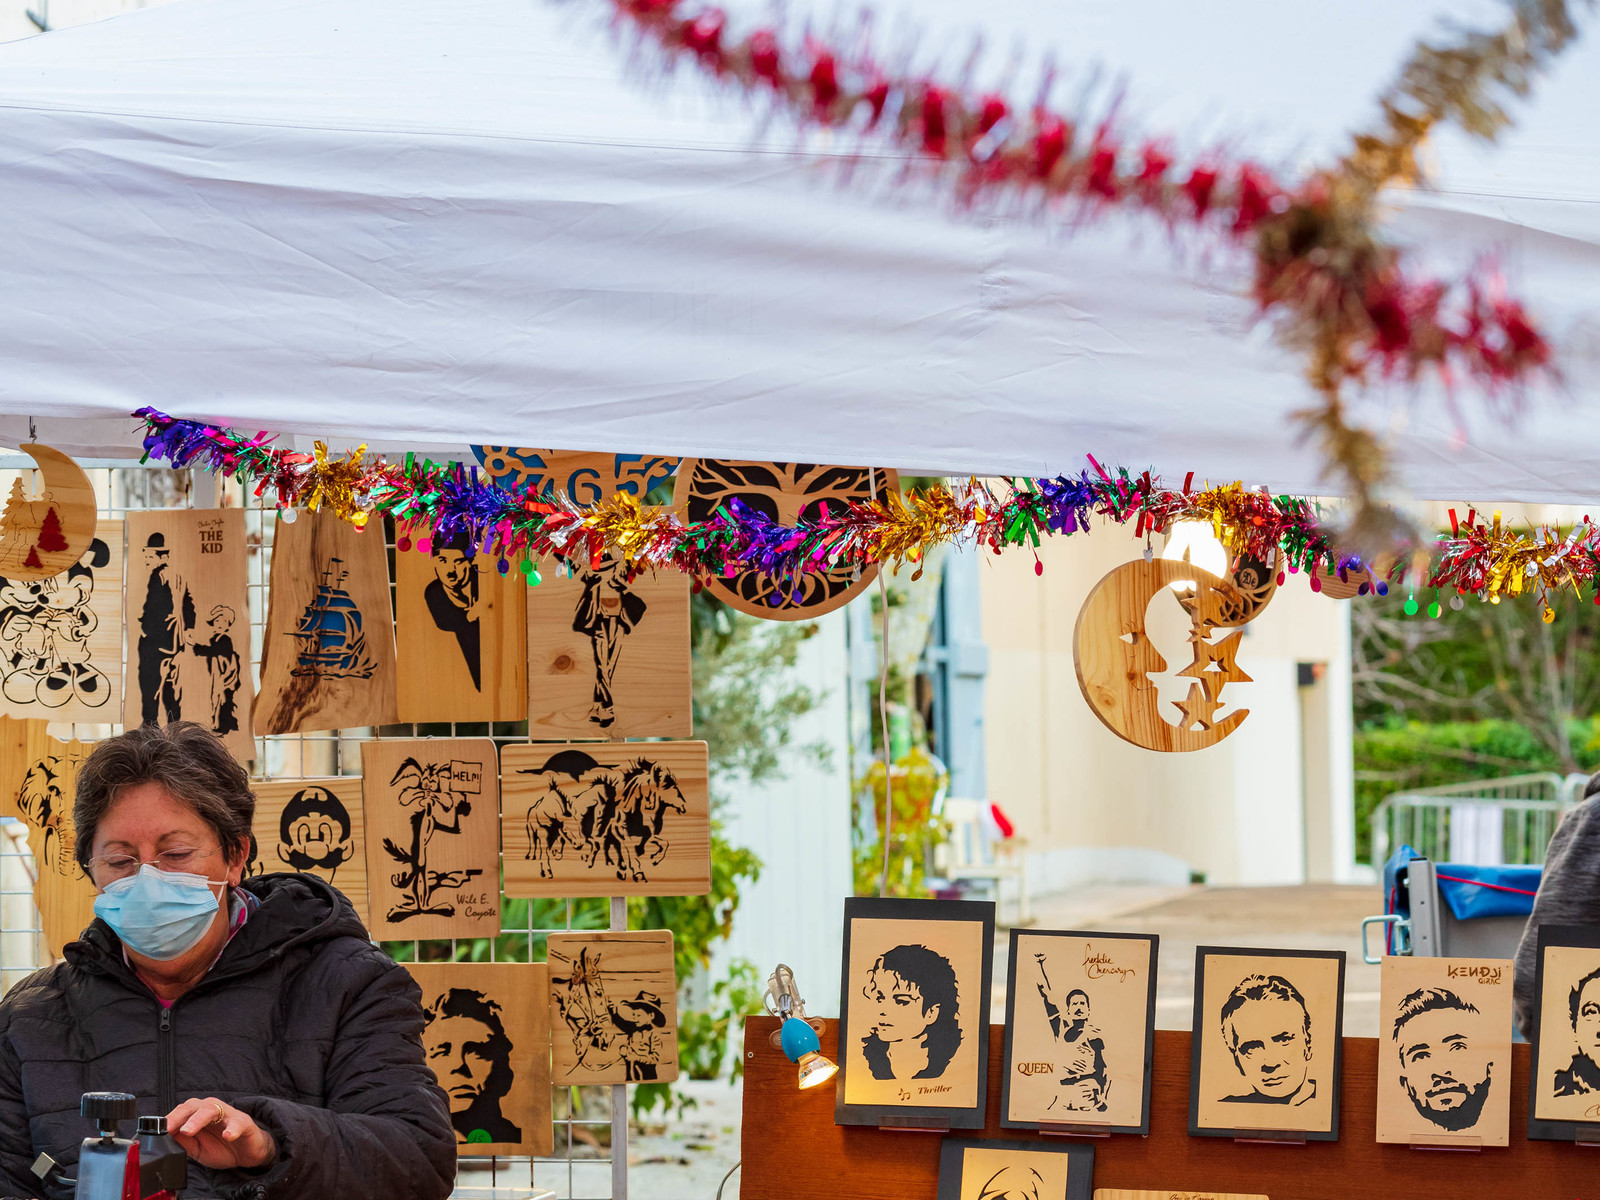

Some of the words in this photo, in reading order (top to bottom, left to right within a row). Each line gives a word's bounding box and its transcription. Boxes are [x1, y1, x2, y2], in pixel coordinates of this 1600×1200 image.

[567, 468, 602, 508] 6
[199, 530, 223, 541] THE
[201, 543, 223, 554] KID
[453, 771, 480, 784] HELP!
[456, 893, 478, 905] Wile
[464, 906, 497, 921] Coyote
[1017, 1062, 1054, 1076] QUEEN
[917, 1086, 952, 1095] Thriller
